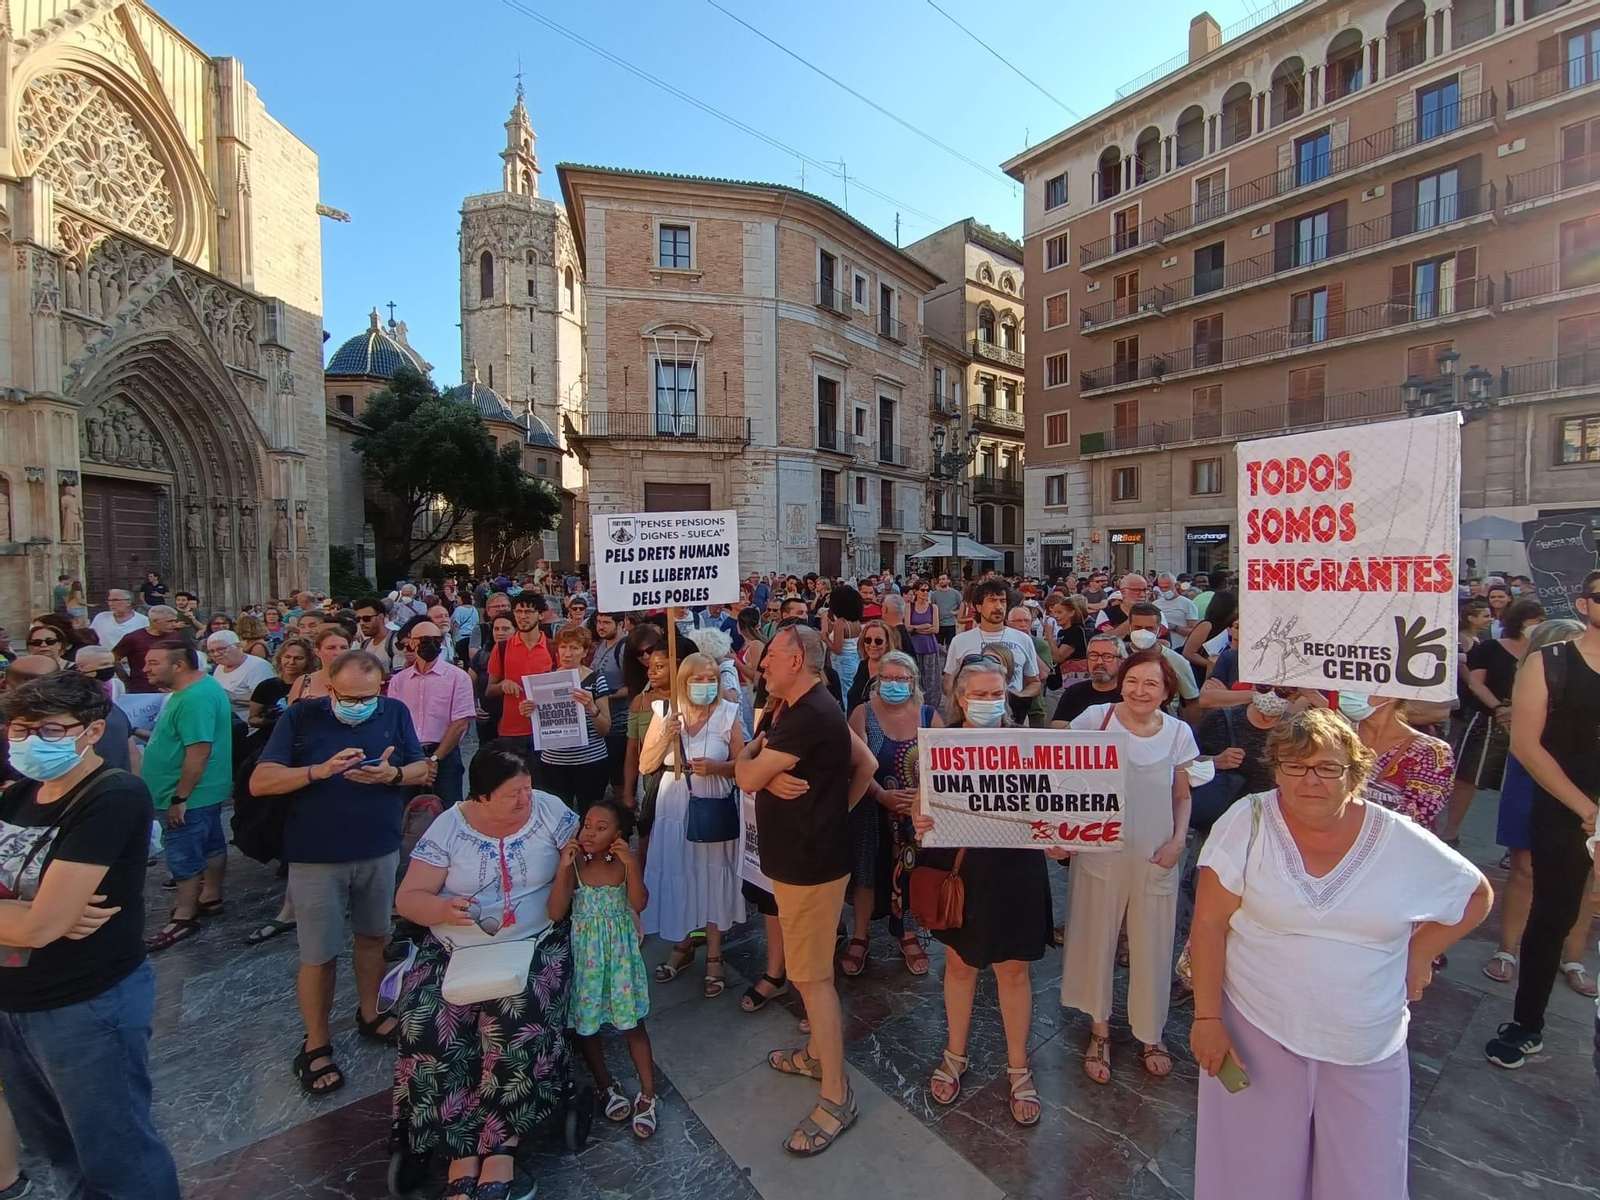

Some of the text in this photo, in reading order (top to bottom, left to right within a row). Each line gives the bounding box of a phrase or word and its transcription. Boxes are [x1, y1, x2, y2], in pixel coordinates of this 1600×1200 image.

[1246, 450, 1353, 497] TODOS
[675, 517, 725, 527] PENSIONS
[1246, 502, 1357, 545] SOMOS
[640, 531, 679, 540] DIGNES
[1111, 534, 1142, 543] BitBase
[605, 543, 730, 563] PELS DRETS HUMANS
[620, 565, 718, 585] I LES LLIBERTATS
[1247, 553, 1454, 594] EMIGRANTES
[632, 588, 709, 606] DELS POBLES
[1303, 642, 1392, 661] RECORTES
[1323, 659, 1391, 684] CERO
[537, 701, 576, 712] LAS VIDAS
[539, 708, 578, 720] NEGRAS
[540, 717, 579, 727] IMPORTAN
[930, 745, 1119, 771] JUSTICIA EN MELILLA
[932, 774, 1051, 793] UNA MISMA
[968, 793, 1120, 812] CLASE OBRERA
[1059, 822, 1122, 842] UCE
